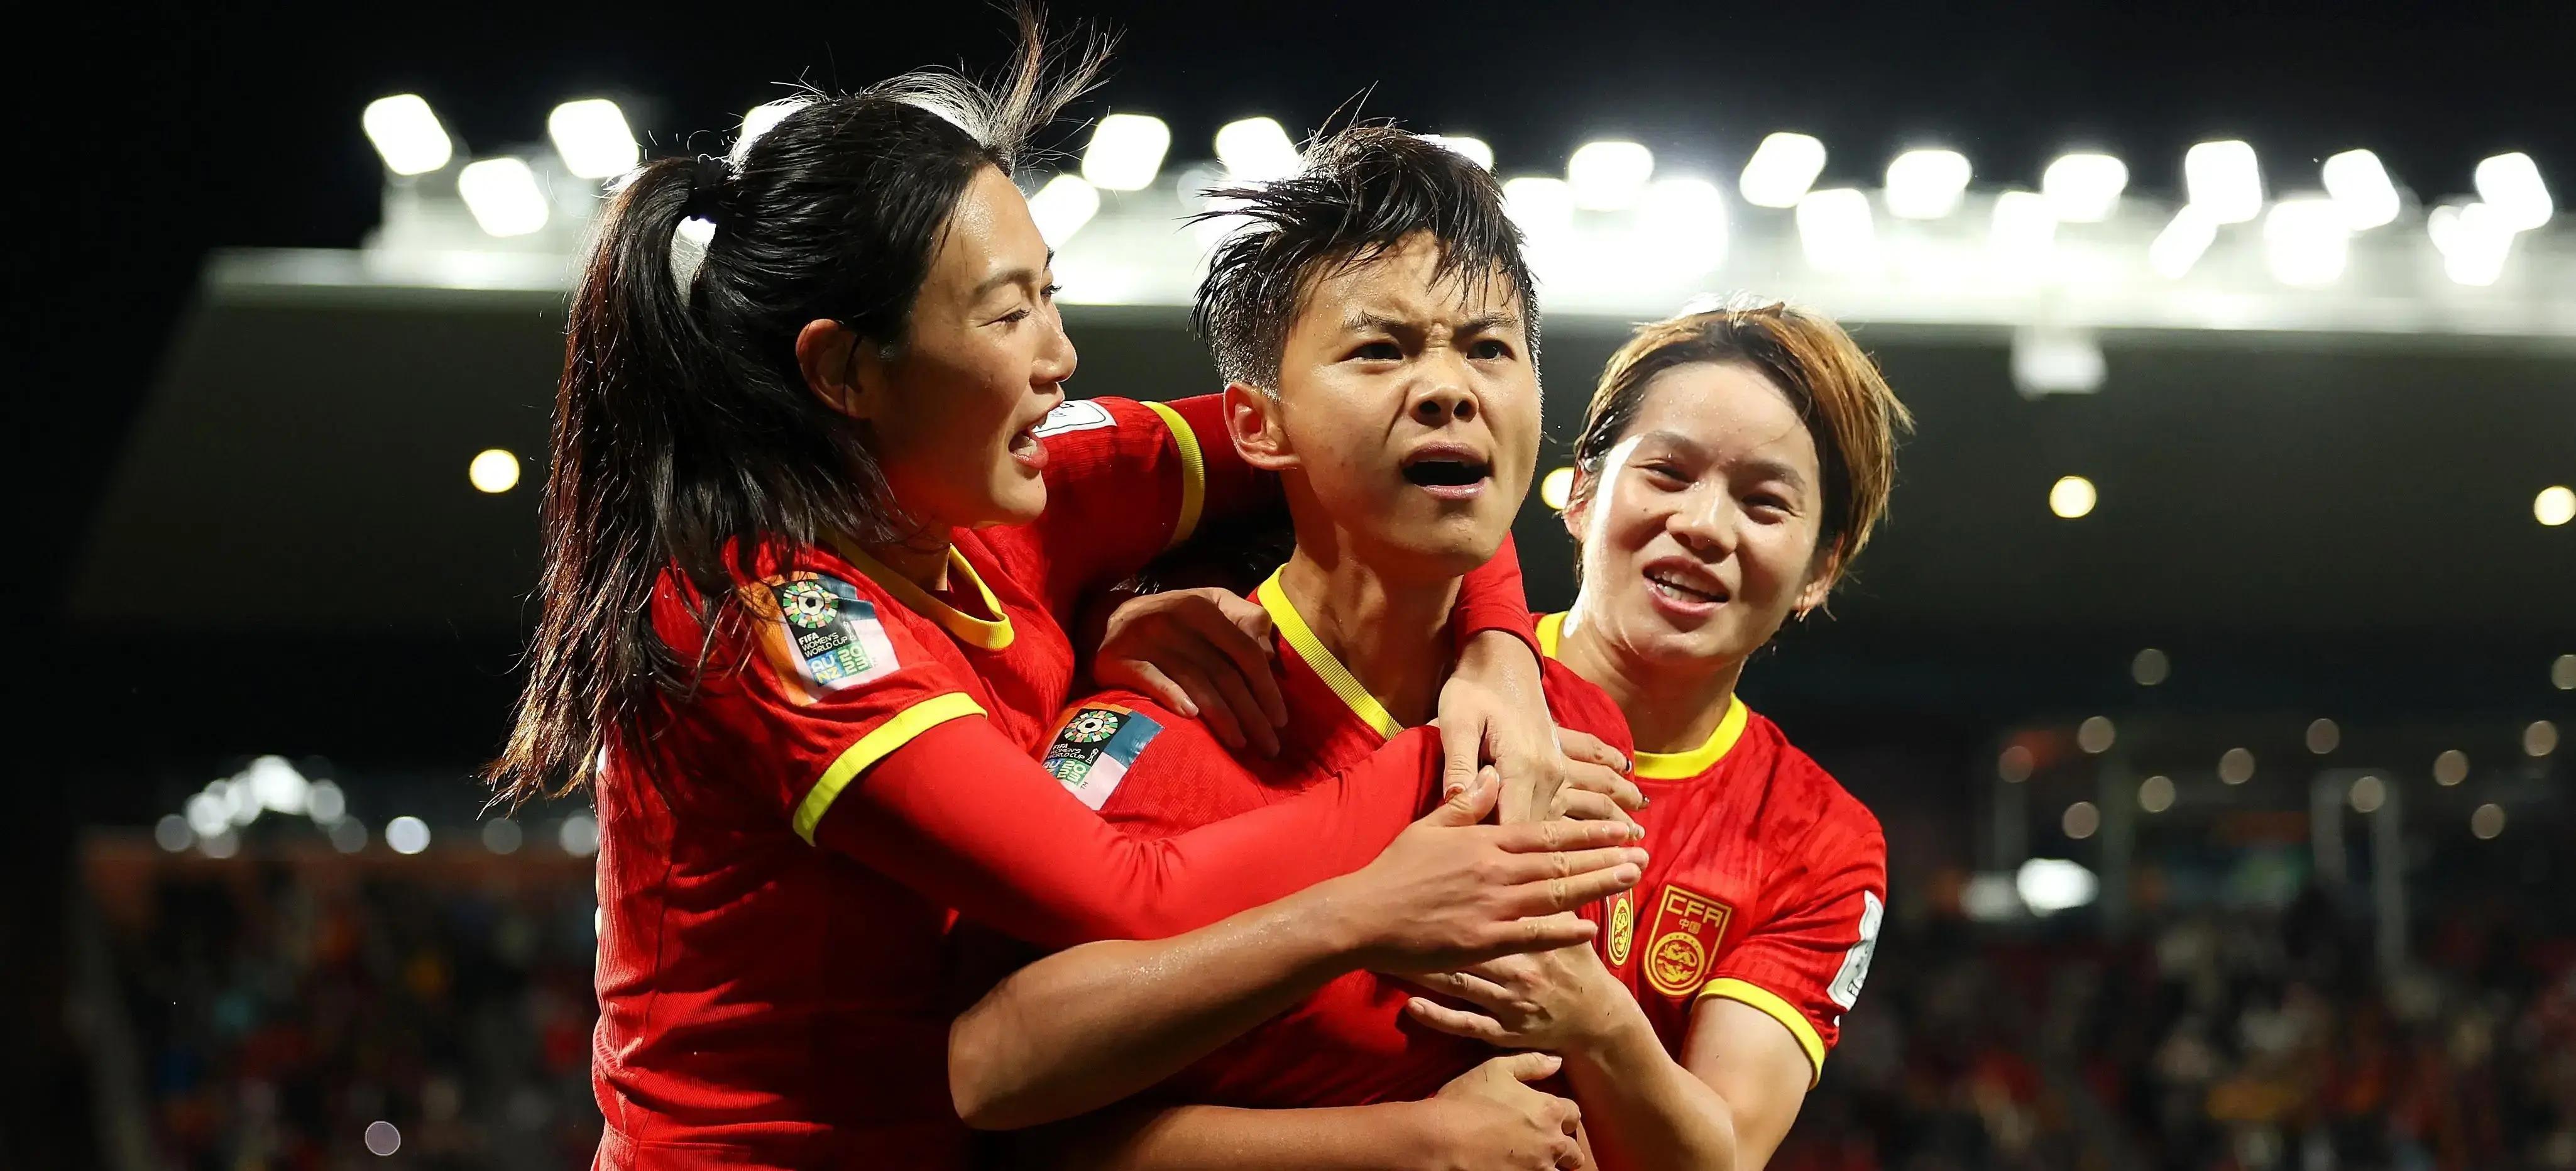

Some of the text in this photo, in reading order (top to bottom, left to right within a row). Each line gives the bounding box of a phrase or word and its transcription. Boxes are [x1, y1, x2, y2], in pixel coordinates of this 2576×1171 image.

[798, 632, 819, 645] FIFA
[802, 632, 840, 651] WOMEN'S
[805, 636, 848, 657] WORLD CUP
[811, 654, 835, 671] AU
[816, 667, 841, 684] NZ
[1666, 894, 1723, 928] CFA
